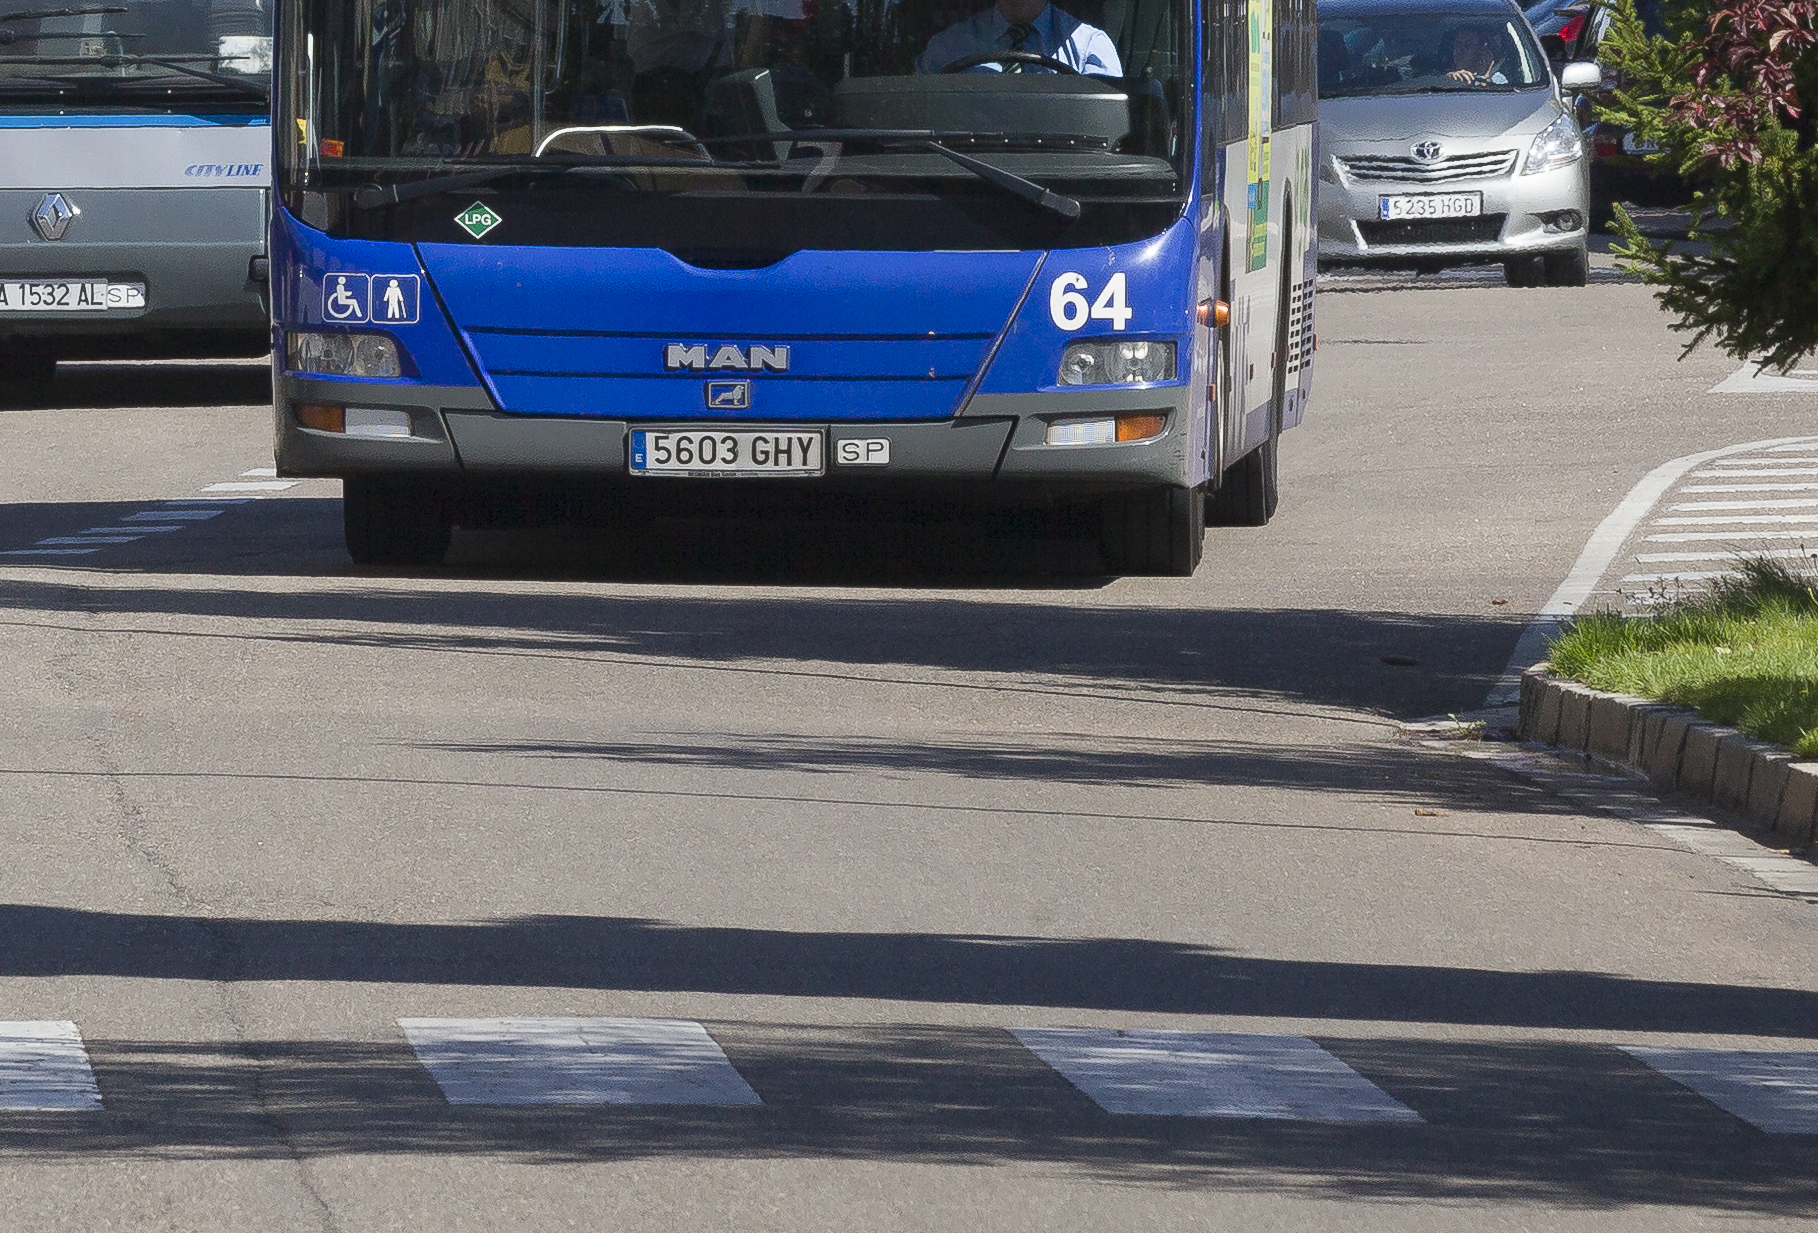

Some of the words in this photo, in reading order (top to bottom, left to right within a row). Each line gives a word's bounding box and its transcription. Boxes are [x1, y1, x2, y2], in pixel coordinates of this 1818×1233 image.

[464, 213, 492, 226] LPG
[1393, 198, 1437, 216] 5235
[18, 282, 70, 307] 1532
[77, 282, 103, 306] AL
[108, 288, 140, 304] SP
[1049, 271, 1133, 331] 64
[665, 343, 790, 369] MAN
[654, 435, 738, 465] 5603
[751, 435, 814, 466] GHY
[842, 442, 885, 462] SP
